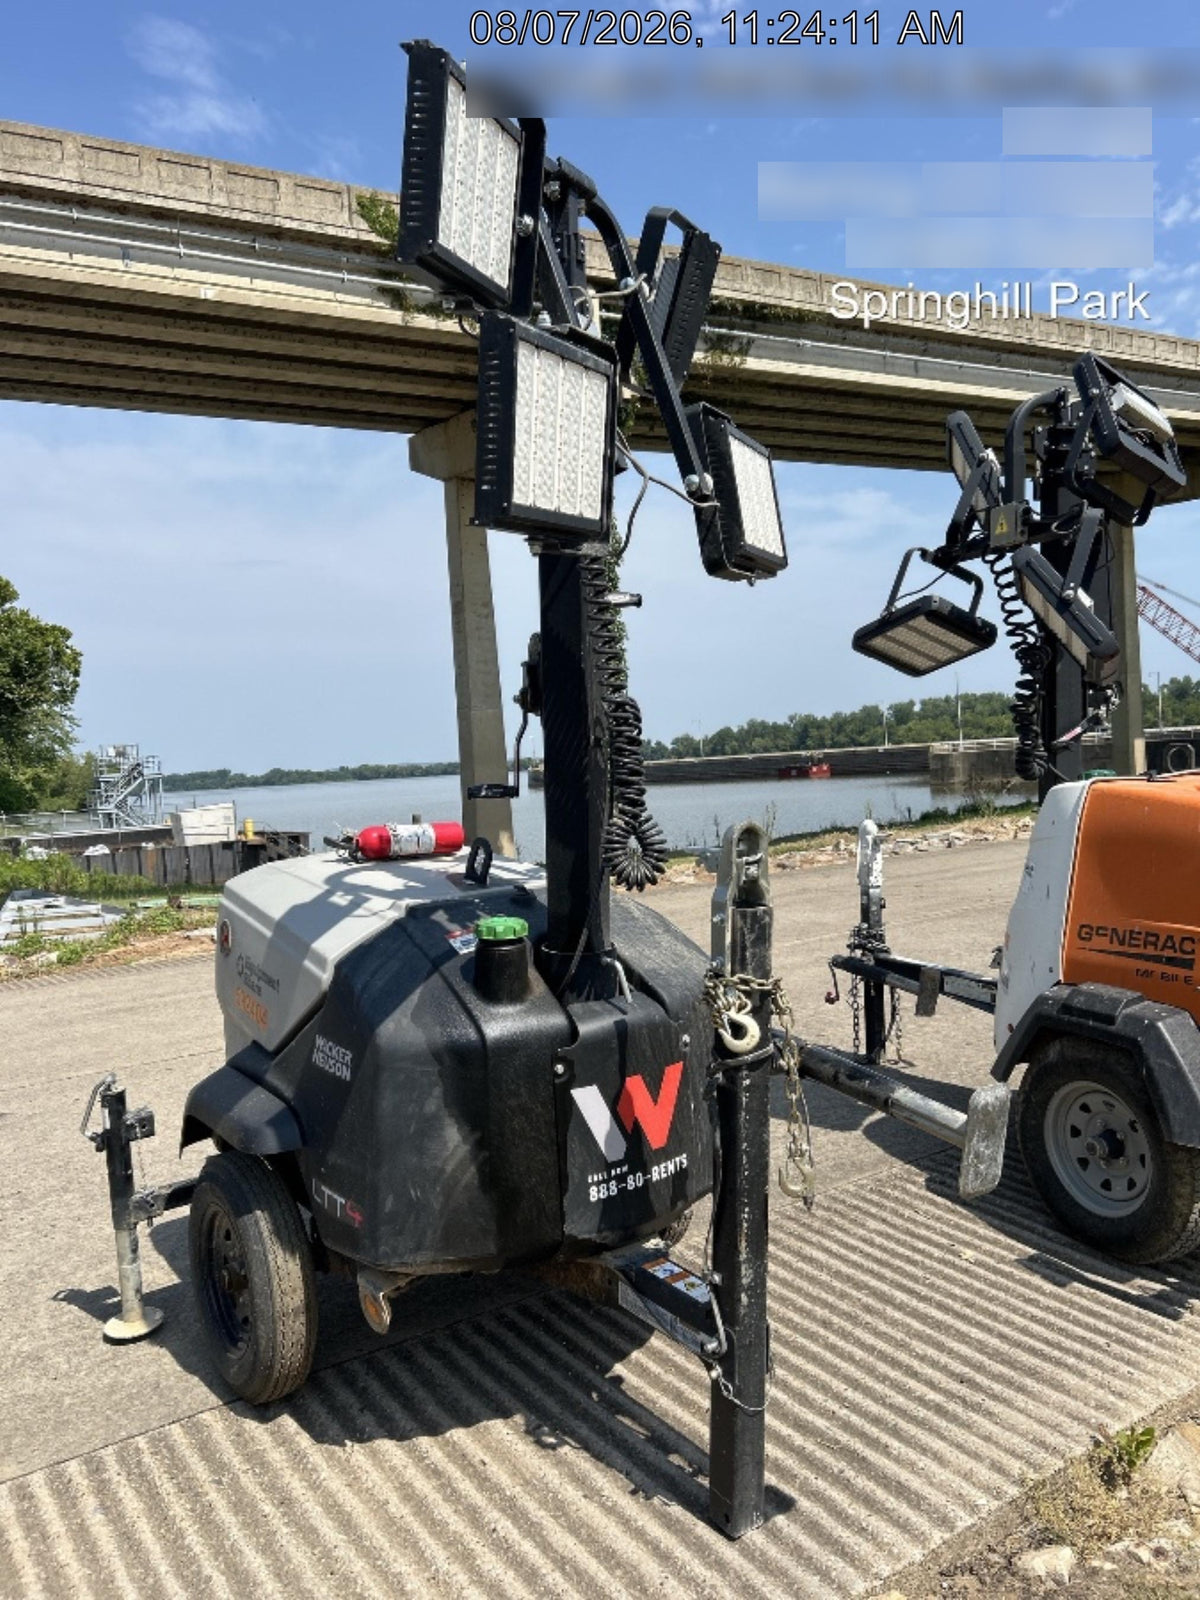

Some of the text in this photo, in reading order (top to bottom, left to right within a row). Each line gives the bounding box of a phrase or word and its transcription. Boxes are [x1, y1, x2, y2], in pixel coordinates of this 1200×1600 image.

[1077, 923, 1196, 955] GENERAC
[312, 1047, 351, 1081] NEUSON
[315, 1034, 353, 1066] WACKER
[588, 1153, 688, 1202] 888-80-RENTS
